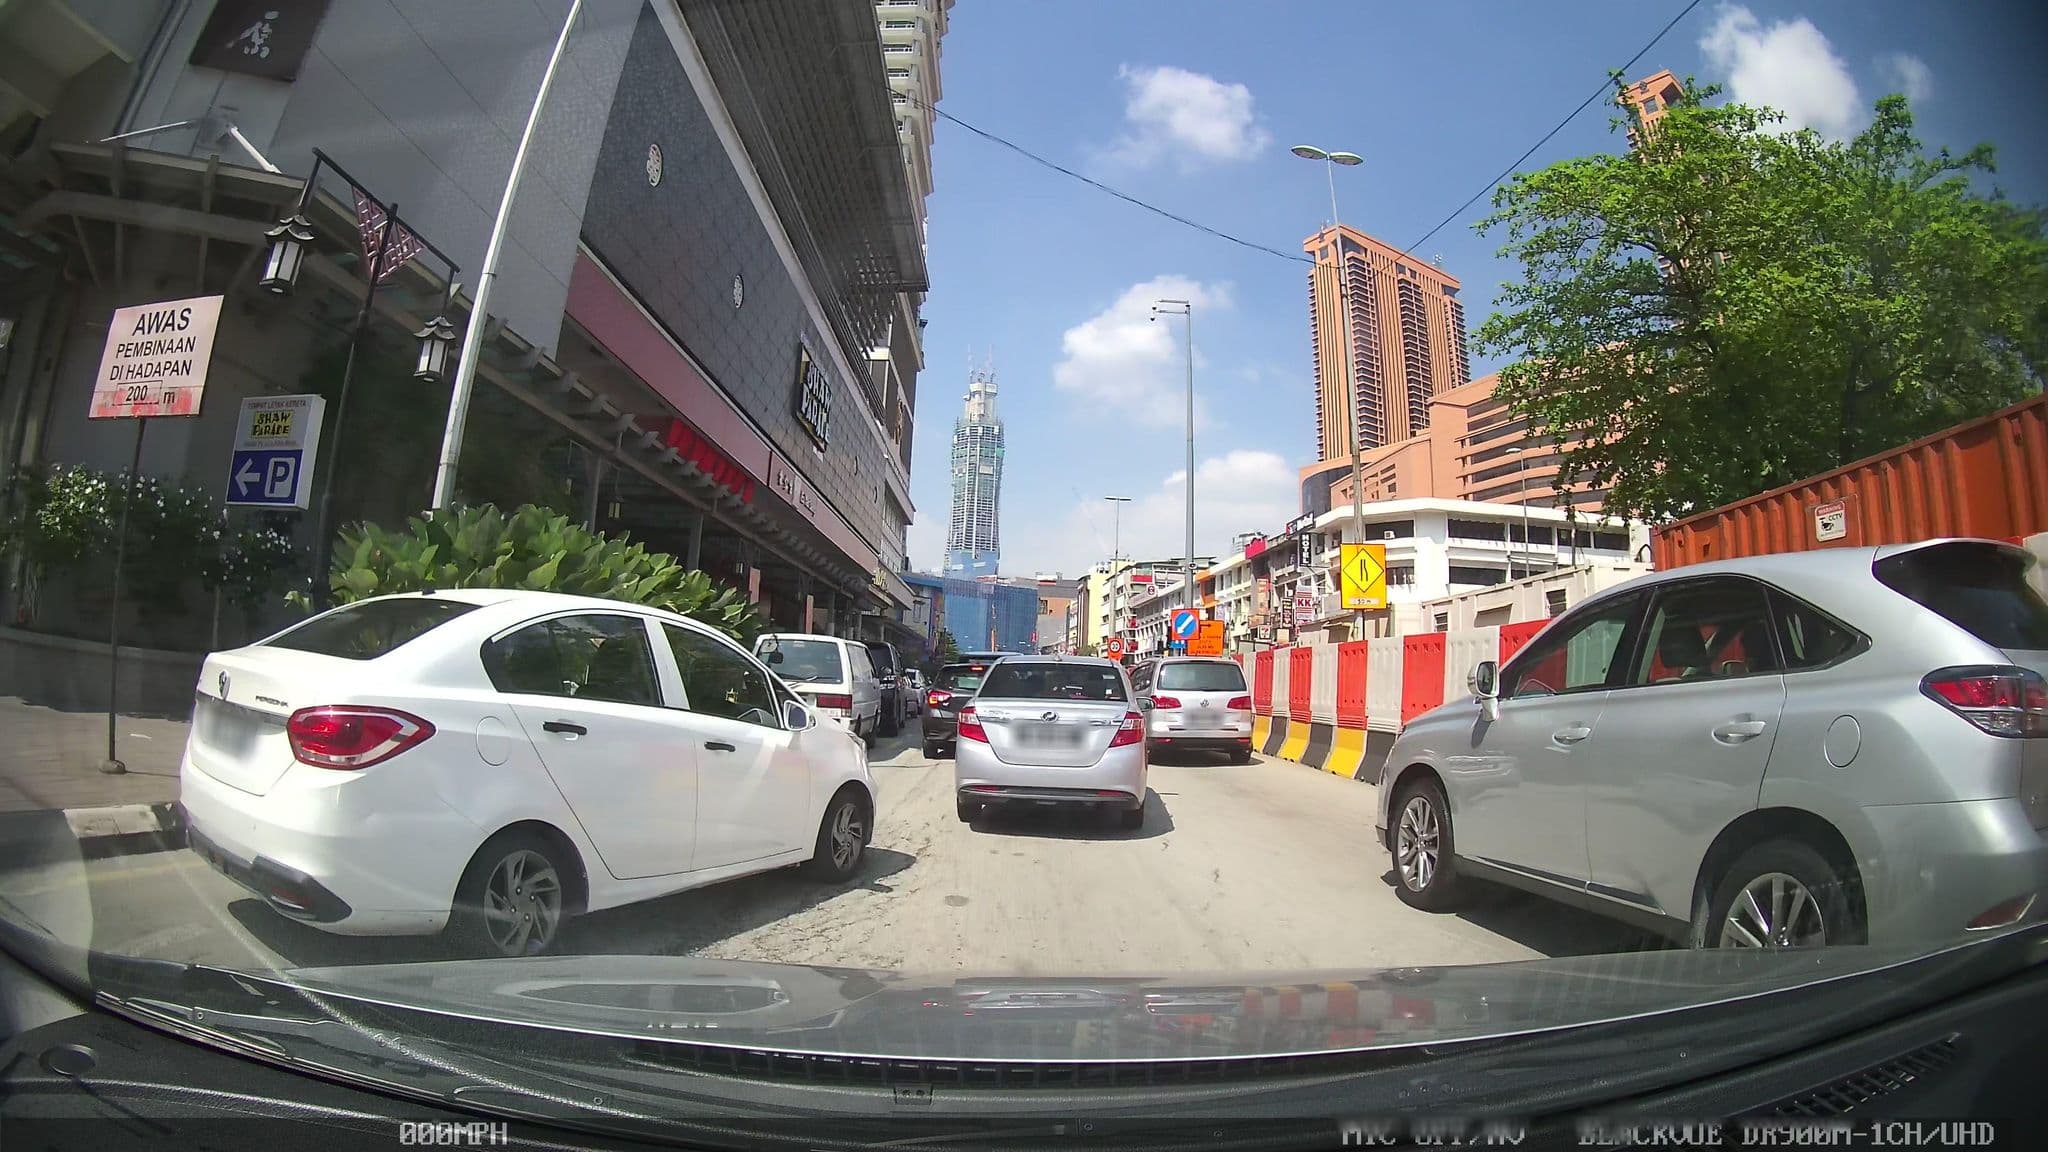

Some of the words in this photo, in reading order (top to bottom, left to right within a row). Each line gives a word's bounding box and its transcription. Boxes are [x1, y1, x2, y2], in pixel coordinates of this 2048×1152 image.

[132, 307, 192, 336] AWAS
[115, 336, 196, 359] PEMBINAAN
[110, 364, 124, 381] DI
[125, 359, 192, 380] HADAPAN
[125, 384, 148, 402] 200
[163, 391, 176, 404] m
[257, 411, 291, 425] SHAW
[252, 423, 290, 436] PARADE
[1828, 512, 1843, 521] CCTV
[1301, 534, 1310, 564] HOTEL
[1297, 599, 1312, 607] KK
